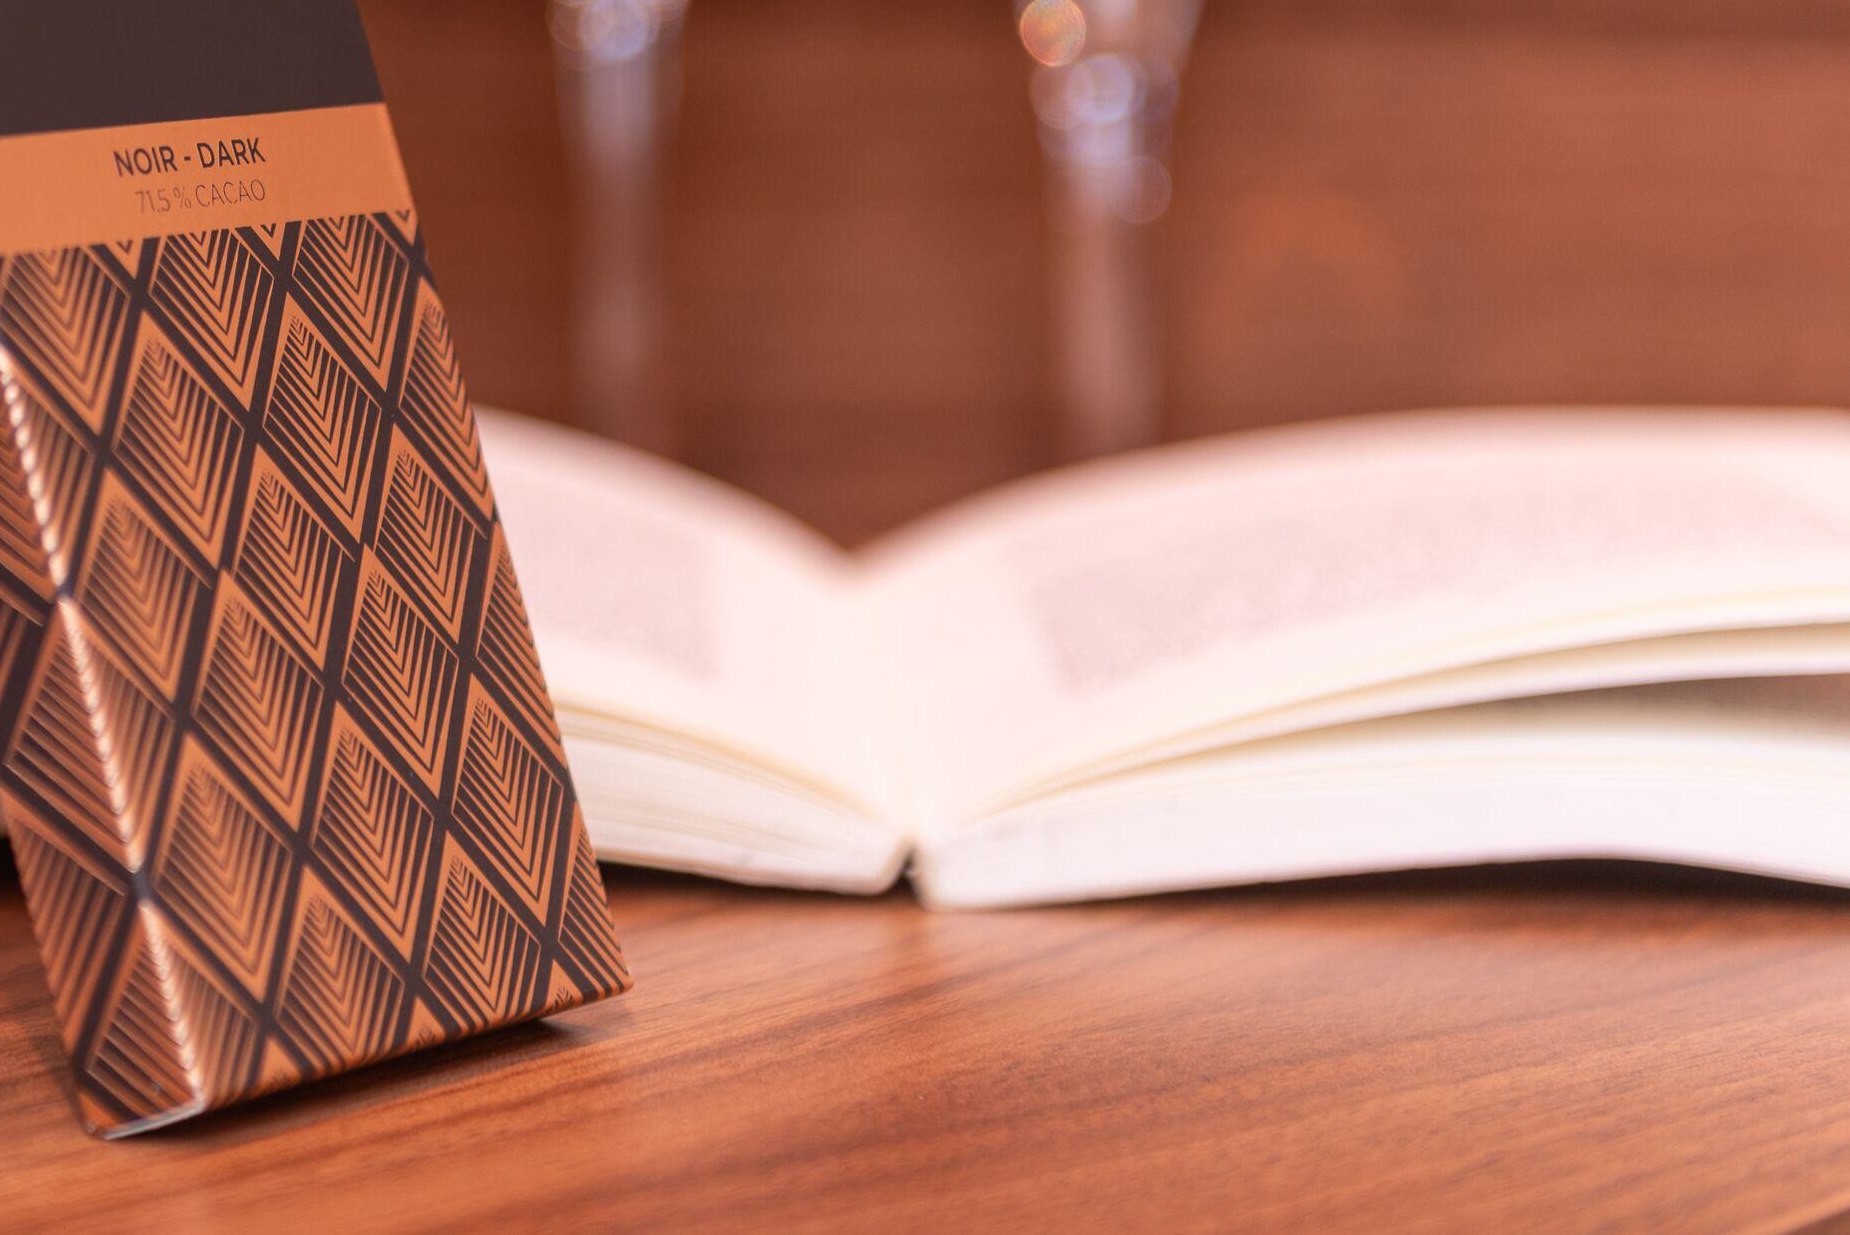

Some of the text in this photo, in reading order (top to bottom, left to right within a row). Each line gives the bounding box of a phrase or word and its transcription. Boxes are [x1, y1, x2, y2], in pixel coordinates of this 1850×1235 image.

[113, 144, 178, 178] NOIR
[196, 137, 266, 169] DARK
[195, 178, 266, 208] CACAO
